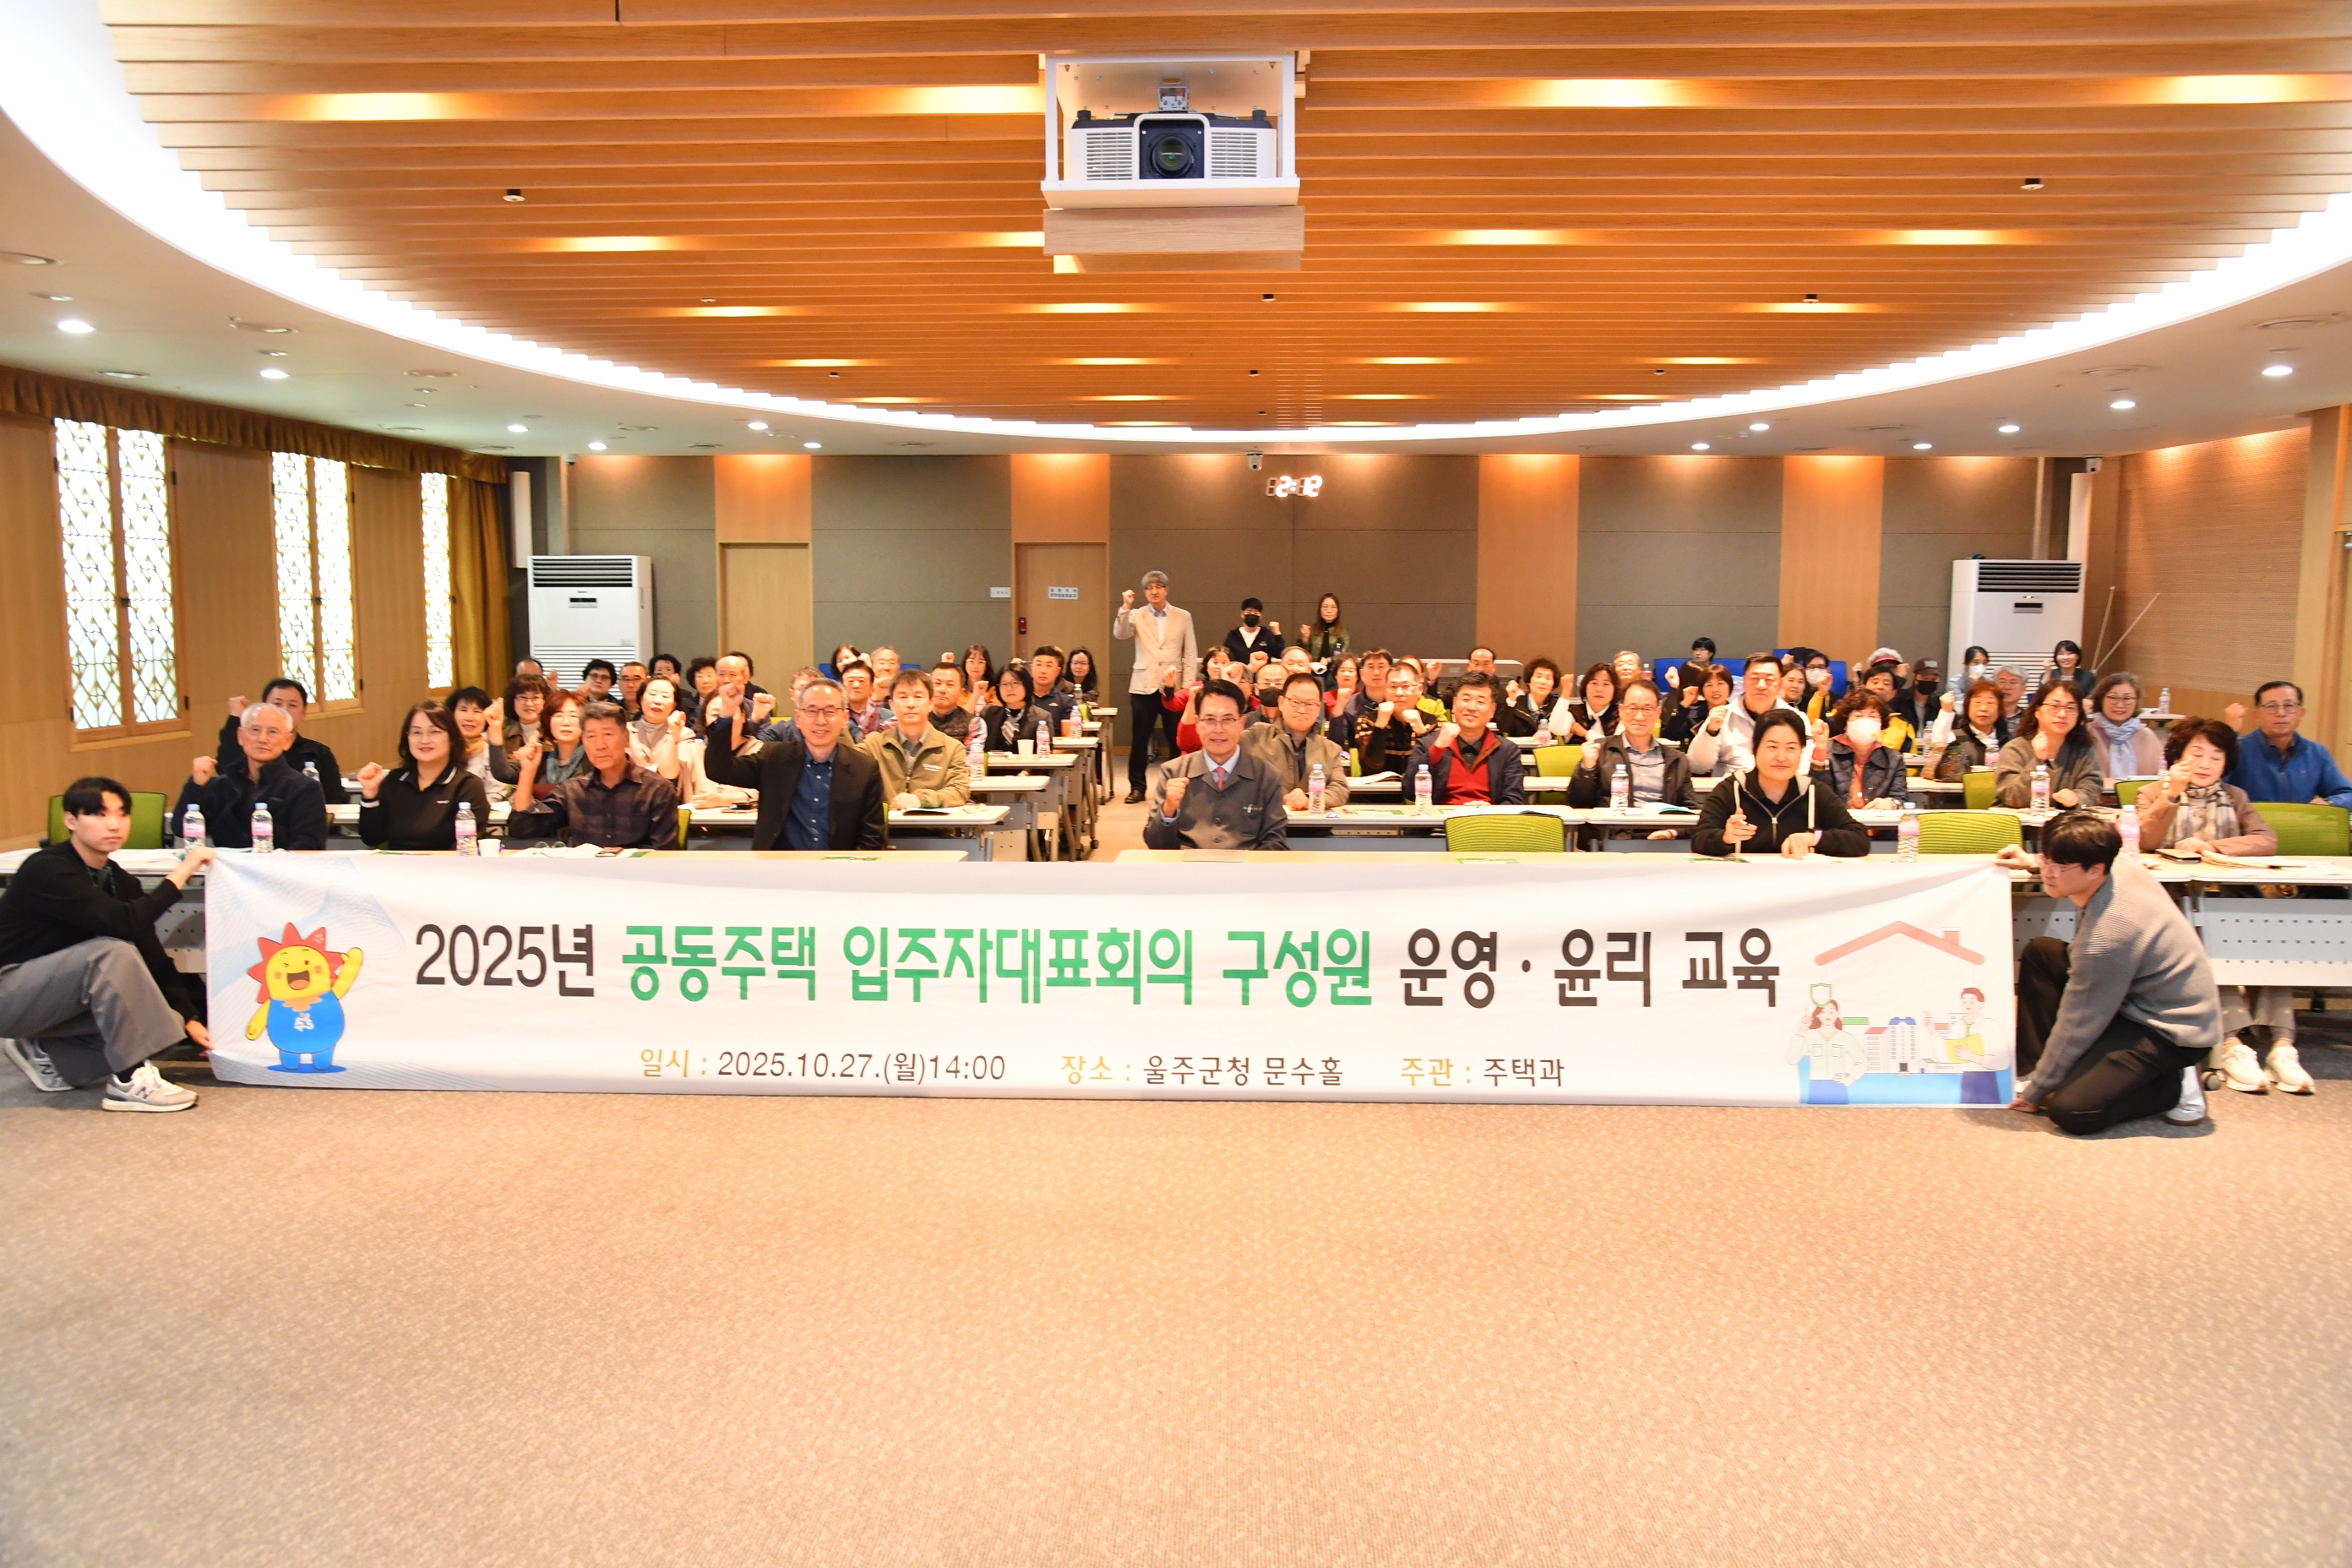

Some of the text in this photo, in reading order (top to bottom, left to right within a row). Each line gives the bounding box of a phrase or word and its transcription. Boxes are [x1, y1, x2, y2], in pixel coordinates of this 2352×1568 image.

[416, 923, 594, 998] 2025년
[622, 925, 816, 1003] 공동주택
[842, 926, 1193, 1006] 입주자대표회의
[1222, 928, 1372, 1008] 구성원
[1399, 928, 1498, 1010] 운영
[1554, 928, 1652, 1008] 윤리
[1681, 928, 1781, 1008] 교육
[640, 1048, 690, 1079] 일시
[718, 1052, 1005, 1084] 2025.10.27.(월)14:00
[1061, 1054, 1113, 1085] 장소
[1142, 1055, 1250, 1086] 울주군청
[1262, 1056, 1343, 1086] 문수홀
[1401, 1058, 1455, 1087] 주관
[1483, 1058, 1565, 1087] 주택과
